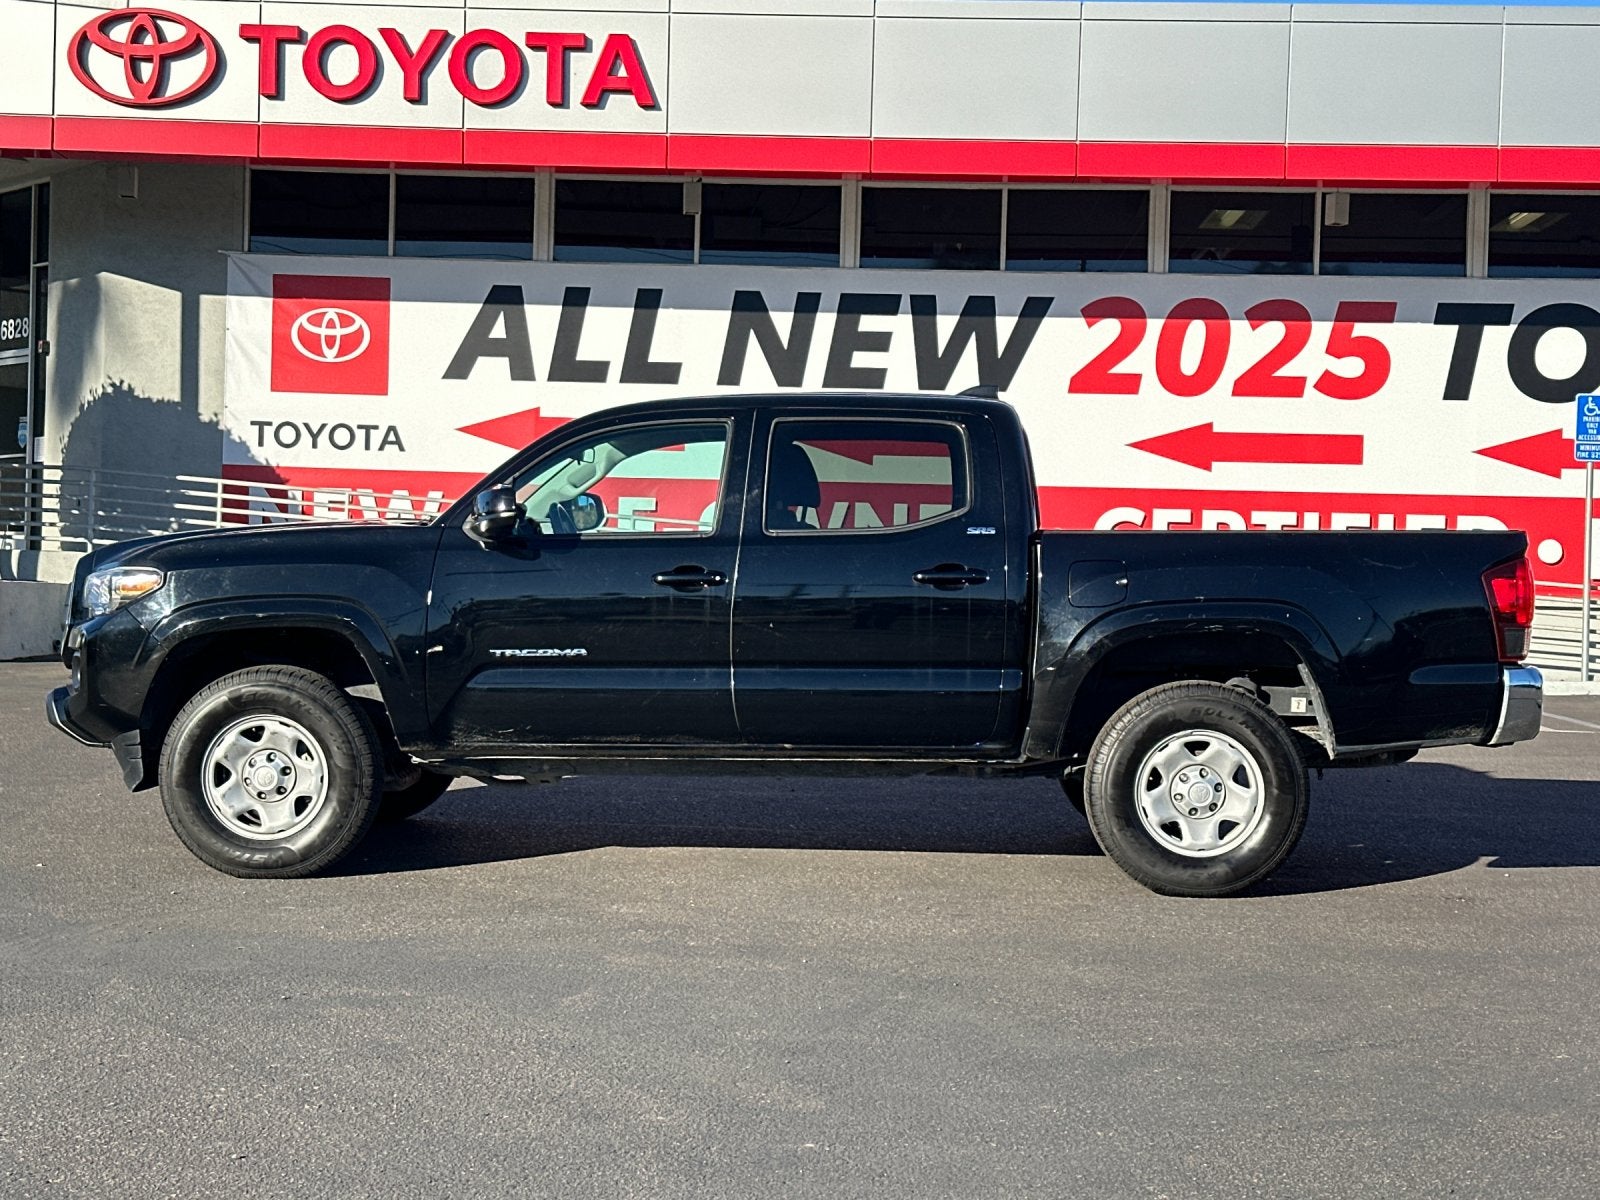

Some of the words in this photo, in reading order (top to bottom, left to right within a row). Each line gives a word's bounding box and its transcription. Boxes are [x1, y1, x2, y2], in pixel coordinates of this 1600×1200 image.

[239, 24, 657, 108] TOYOTA
[1, 317, 29, 340] 6828
[442, 284, 683, 385] ALL
[717, 290, 1055, 392] NEW
[1068, 296, 1398, 401] 2025
[250, 420, 406, 452] TOYOTA
[489, 648, 588, 657] TACOMA
